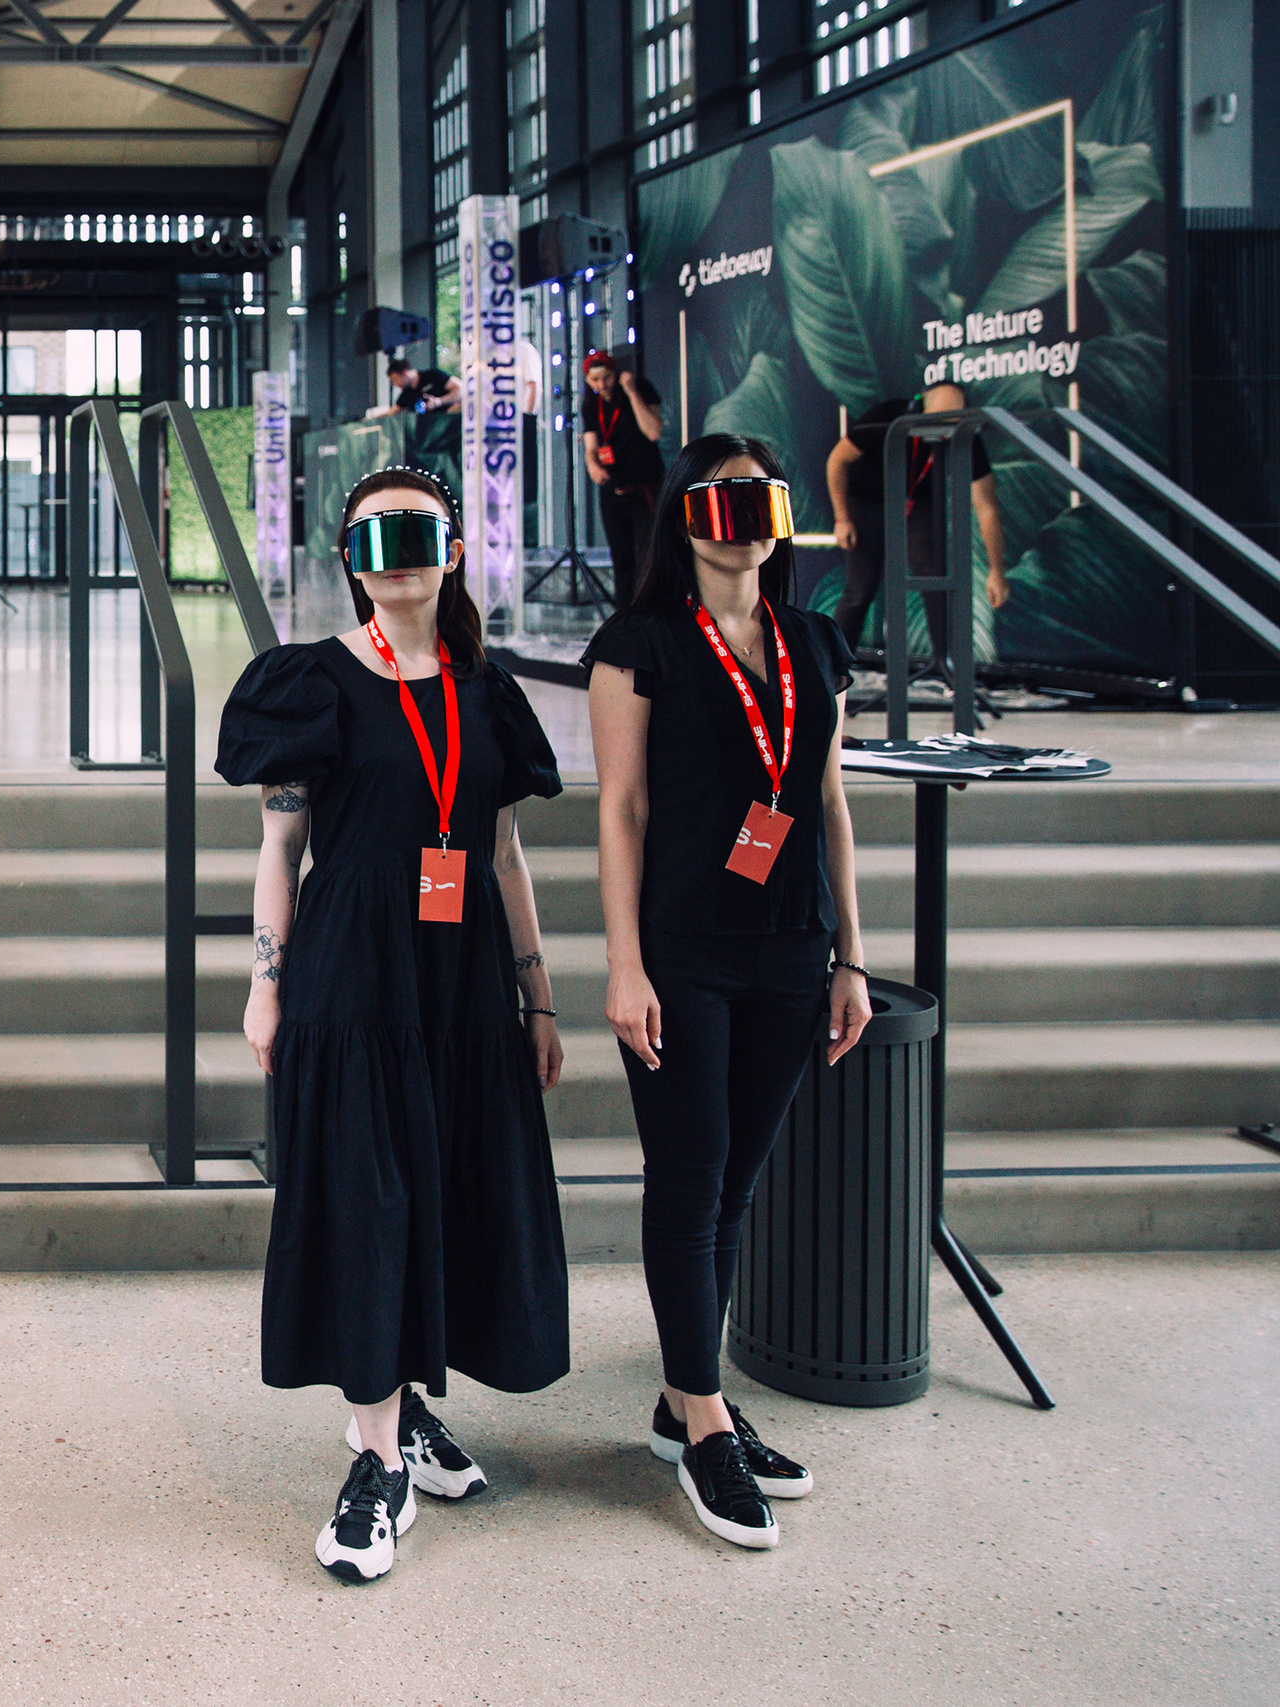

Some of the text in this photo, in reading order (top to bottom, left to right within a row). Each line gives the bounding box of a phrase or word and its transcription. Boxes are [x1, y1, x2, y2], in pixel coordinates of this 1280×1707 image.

[923, 308, 1044, 352] The Nature
[481, 240, 517, 472] Silent disco
[923, 340, 1081, 386] of Technology
[264, 400, 287, 464] Unity
[704, 624, 728, 657] SHINE
[730, 671, 754, 708] SHINE
[782, 673, 793, 709] SHINE
[753, 725, 773, 766] SHINE
